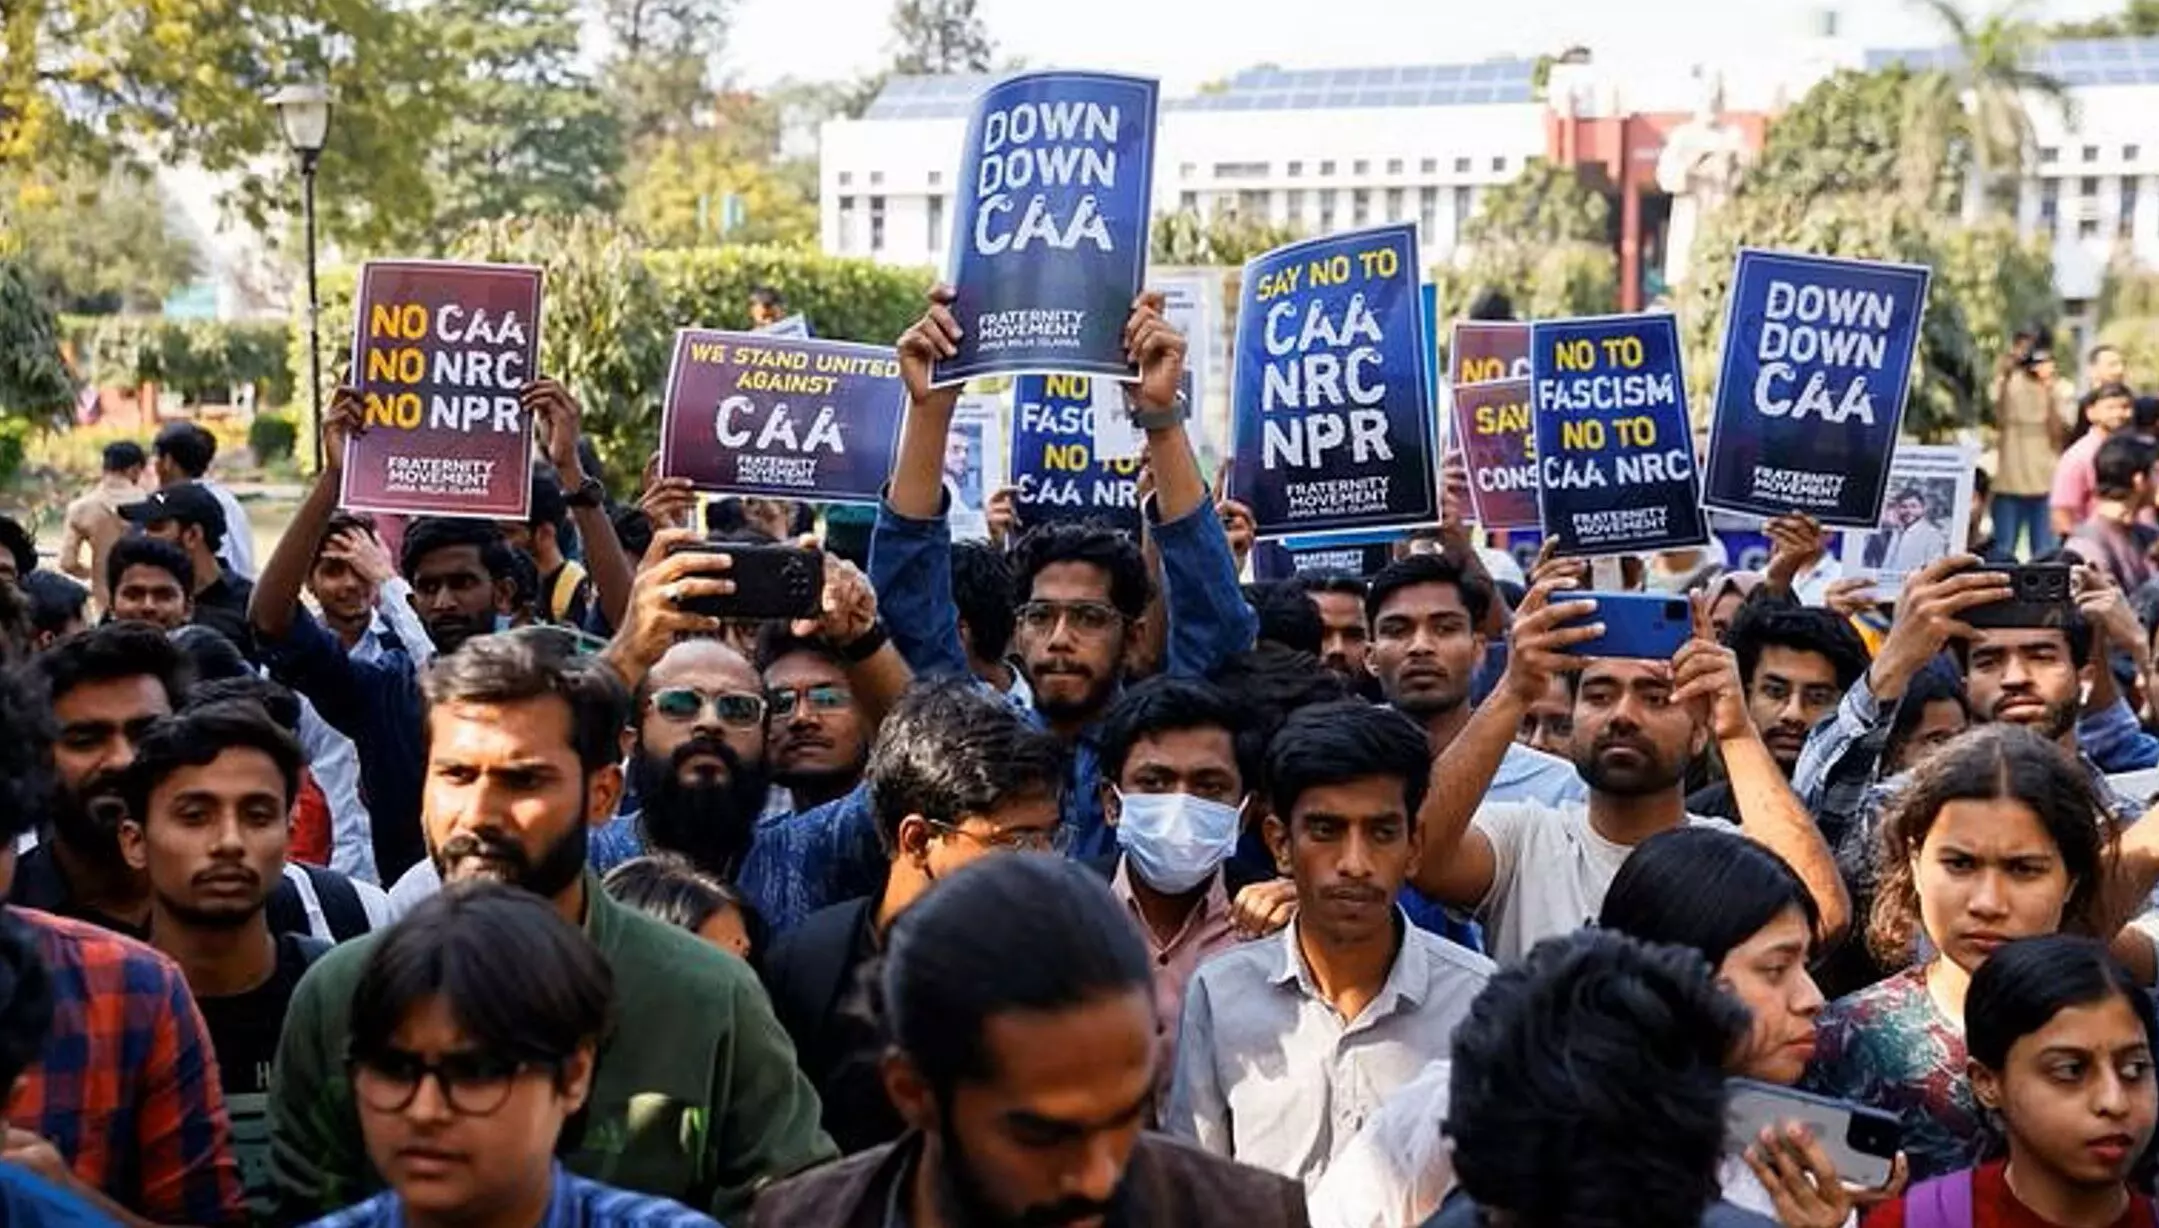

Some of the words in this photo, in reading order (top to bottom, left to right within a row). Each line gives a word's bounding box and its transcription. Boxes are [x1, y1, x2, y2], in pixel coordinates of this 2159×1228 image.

[984, 102, 1120, 153] DOWN
[979, 146, 1117, 197] DOWN
[975, 194, 1114, 255] CAA
[1256, 264, 1302, 302] SAY
[1309, 256, 1349, 288] NO
[1359, 248, 1397, 279] TO
[979, 309, 1086, 325] FRATERNITY
[1766, 280, 1894, 329] DOWN
[371, 303, 428, 338] NO
[436, 303, 526, 344] CAA
[979, 321, 1082, 340] MOVEMENT
[1265, 293, 1383, 355] CAA
[691, 343, 728, 364] WE
[733, 347, 808, 370] STAND
[816, 353, 900, 378] UNITED
[1554, 340, 1595, 371] NO
[1602, 337, 1643, 369] TO
[1758, 322, 1887, 369] DOWN
[367, 348, 425, 384] NO
[433, 350, 524, 389] NRC
[736, 371, 838, 394] AGAINST
[1262, 347, 1386, 411] NRC
[1462, 358, 1505, 382] NO
[1044, 375, 1089, 400] NO
[1539, 374, 1675, 411] FASCISM
[1754, 361, 1875, 424] CAA
[364, 392, 422, 429] NO
[430, 394, 520, 432] NPR
[715, 395, 845, 453] CAA
[1021, 402, 1097, 437] FASC
[1475, 403, 1531, 434] SAV
[1263, 409, 1394, 469] NPR
[1562, 419, 1605, 450] NO
[1612, 416, 1656, 448] TO
[388, 456, 495, 473] FRATERNITY
[736, 454, 818, 471] FRATERNITY
[1043, 444, 1089, 472] NO
[1543, 456, 1608, 489] CAA
[1615, 450, 1692, 486] NRC
[388, 468, 490, 486] MOVEMENT
[1017, 473, 1083, 507] CAA
[1093, 480, 1138, 508] NR
[1287, 476, 1390, 497] FRATERNITY
[1478, 464, 1538, 491] CONS
[1753, 478, 1843, 498] MOVEMENT
[1754, 466, 1846, 485] FRATERNITY
[1289, 488, 1388, 509] MOVEMENT
[1572, 506, 1668, 526] FRATERNITY
[1575, 517, 1667, 536] MOVEMENT
